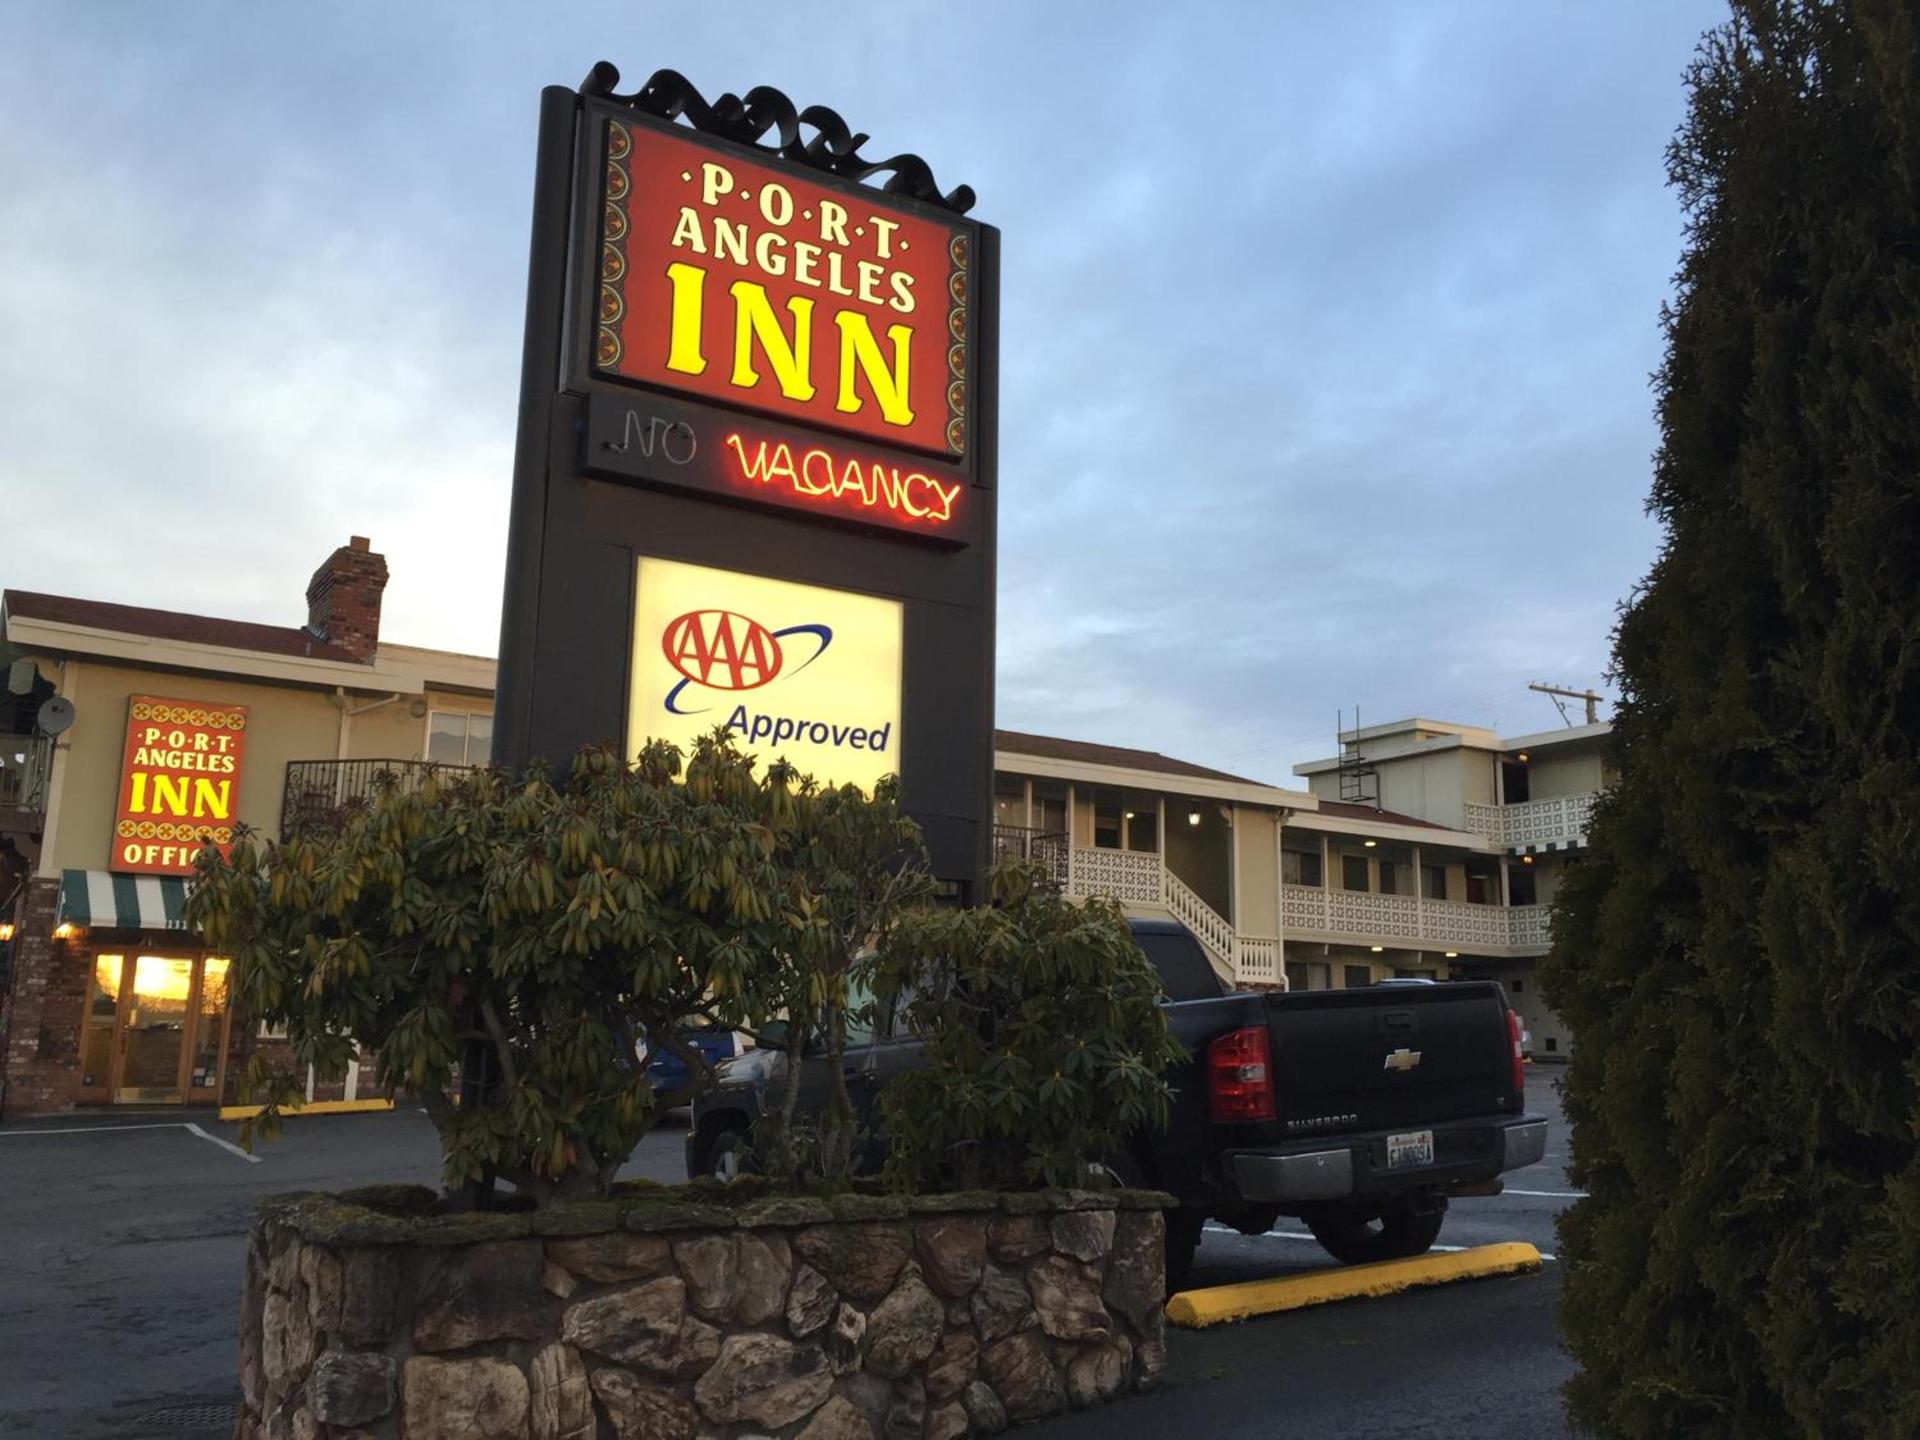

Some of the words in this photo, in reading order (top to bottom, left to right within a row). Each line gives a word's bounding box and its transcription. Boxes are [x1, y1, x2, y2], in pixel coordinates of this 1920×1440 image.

[671, 207, 917, 313] ANGELES
[665, 261, 916, 427] INN
[610, 409, 697, 465] NO
[727, 434, 960, 520] VACANCY
[672, 610, 774, 690] AAA
[134, 747, 235, 773] ANGELES
[726, 705, 891, 752] Approved
[129, 772, 231, 819] INN
